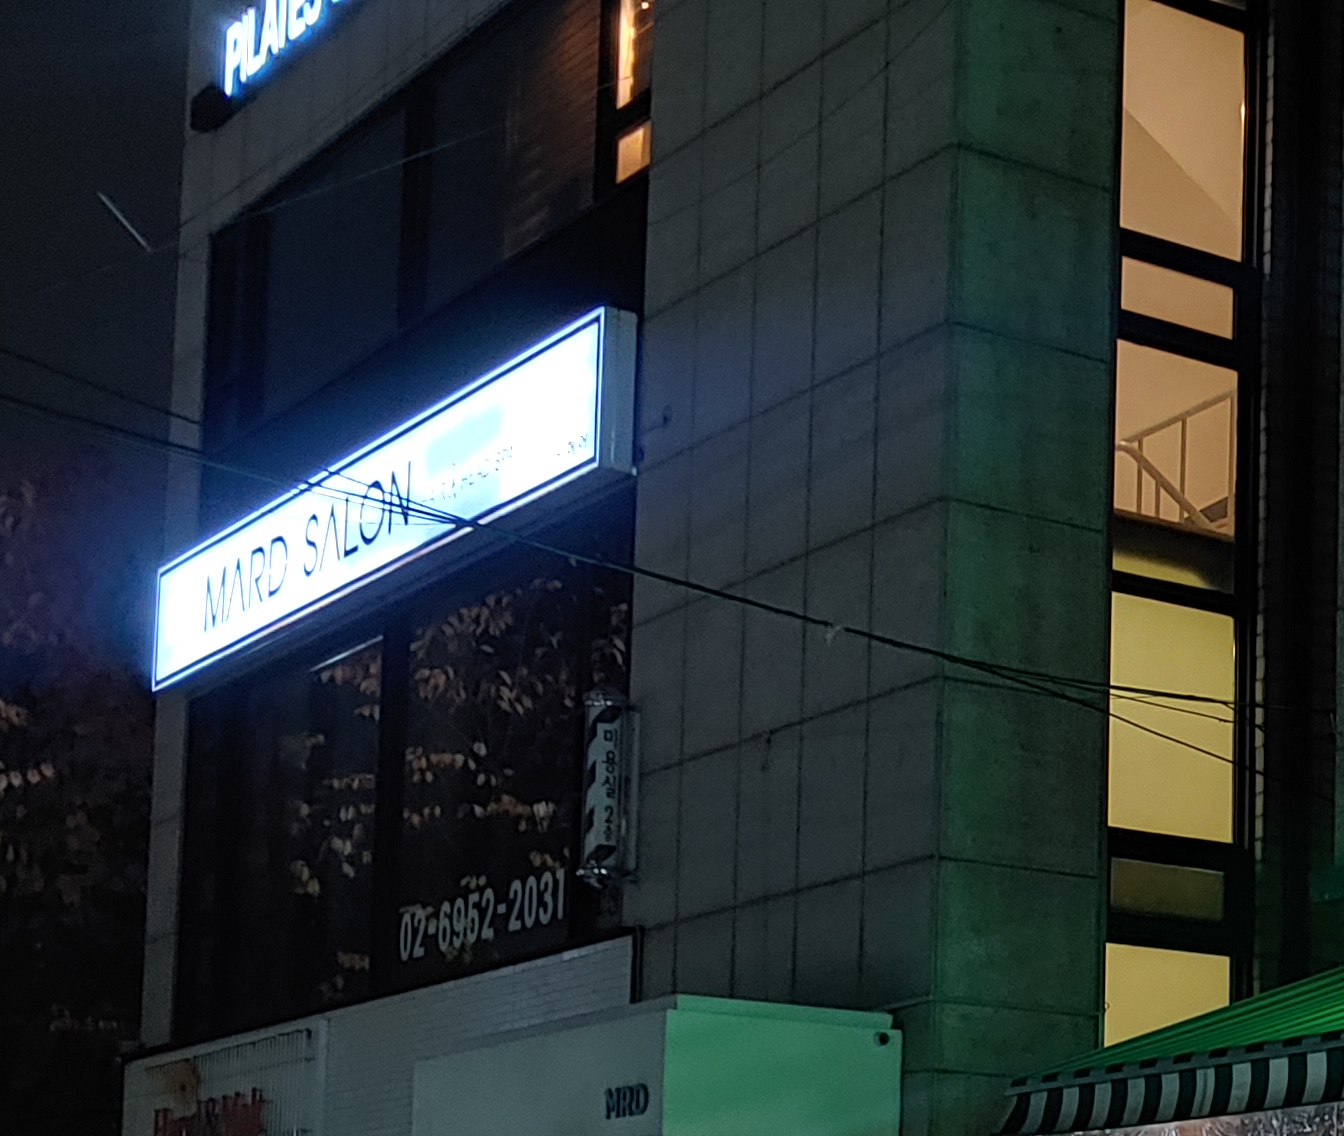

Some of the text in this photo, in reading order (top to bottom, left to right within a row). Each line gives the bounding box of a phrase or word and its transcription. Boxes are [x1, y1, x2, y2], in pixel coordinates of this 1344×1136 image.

[204, 461, 411, 632] MARD SALON
[601, 728, 617, 799] 미용실
[400, 868, 565, 962] 02-6952-2031
